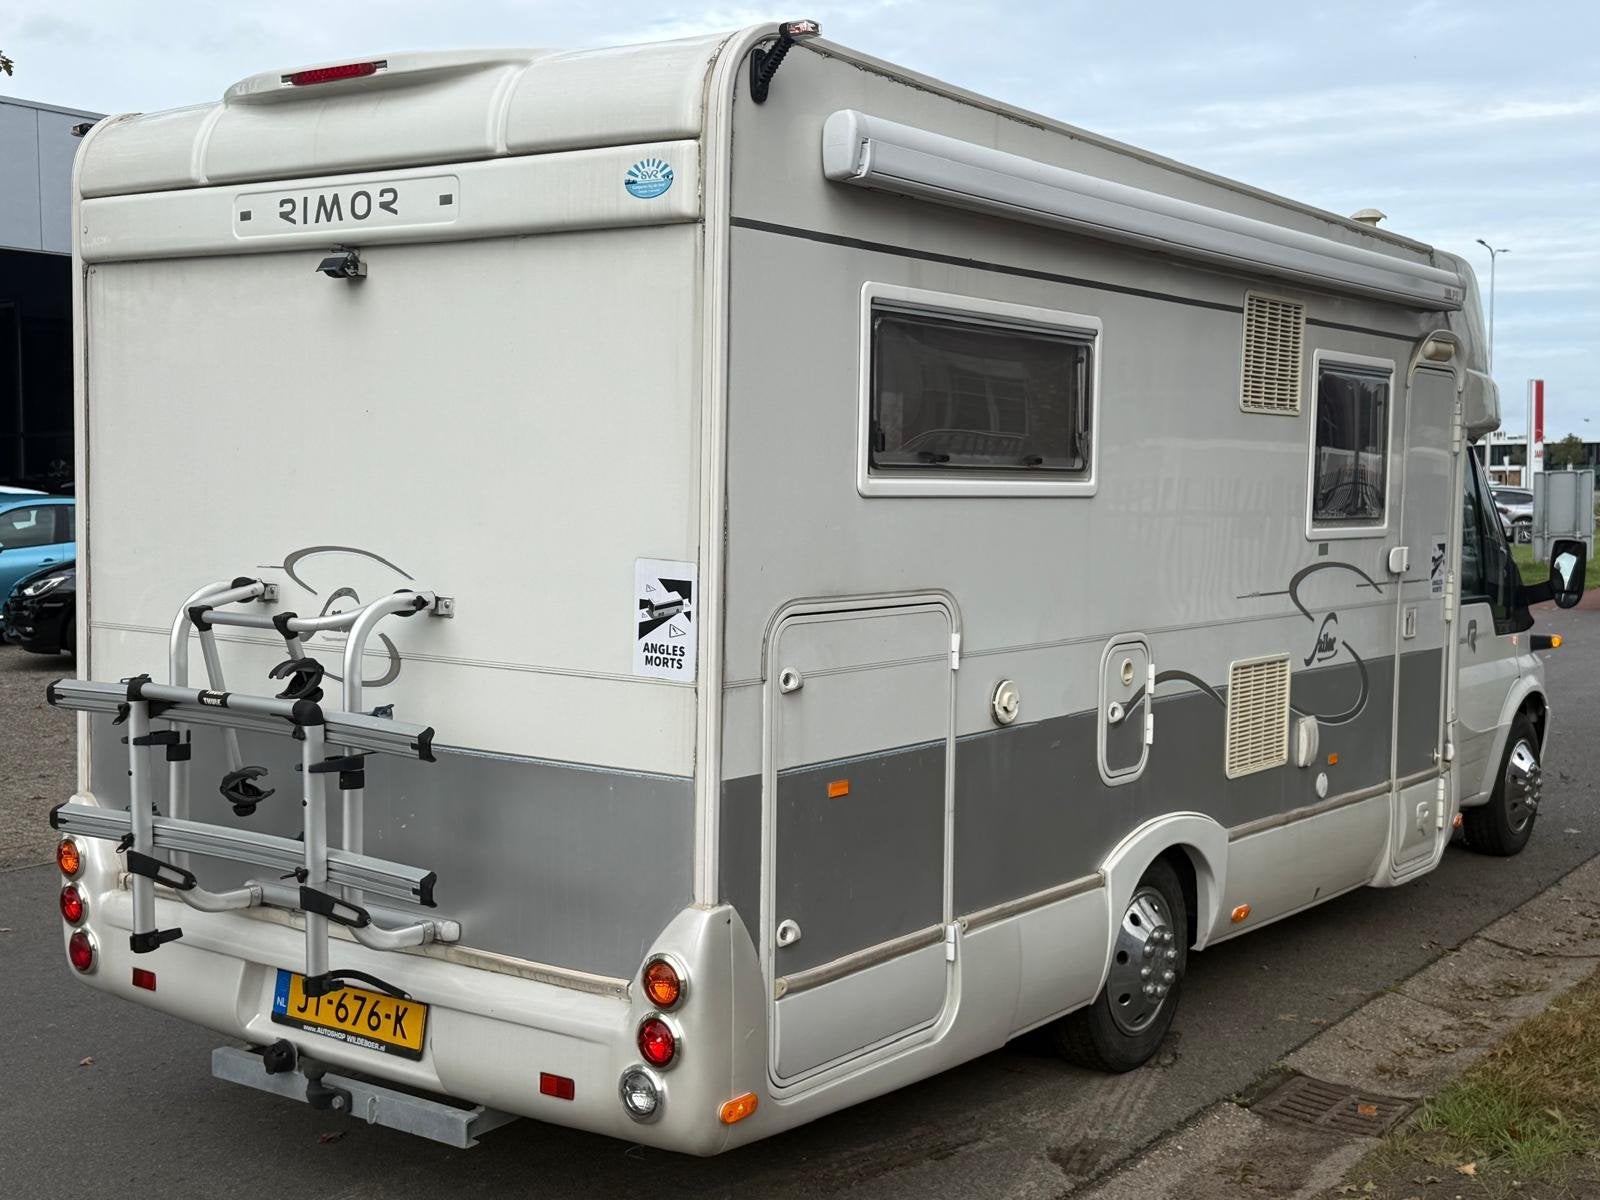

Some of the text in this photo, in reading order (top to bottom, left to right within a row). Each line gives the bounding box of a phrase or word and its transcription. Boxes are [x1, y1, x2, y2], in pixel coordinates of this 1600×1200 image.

[278, 187, 399, 225] RIMOR
[642, 642, 686, 657] ANGLES
[644, 654, 683, 670] MORTS
[276, 996, 287, 1008] NL
